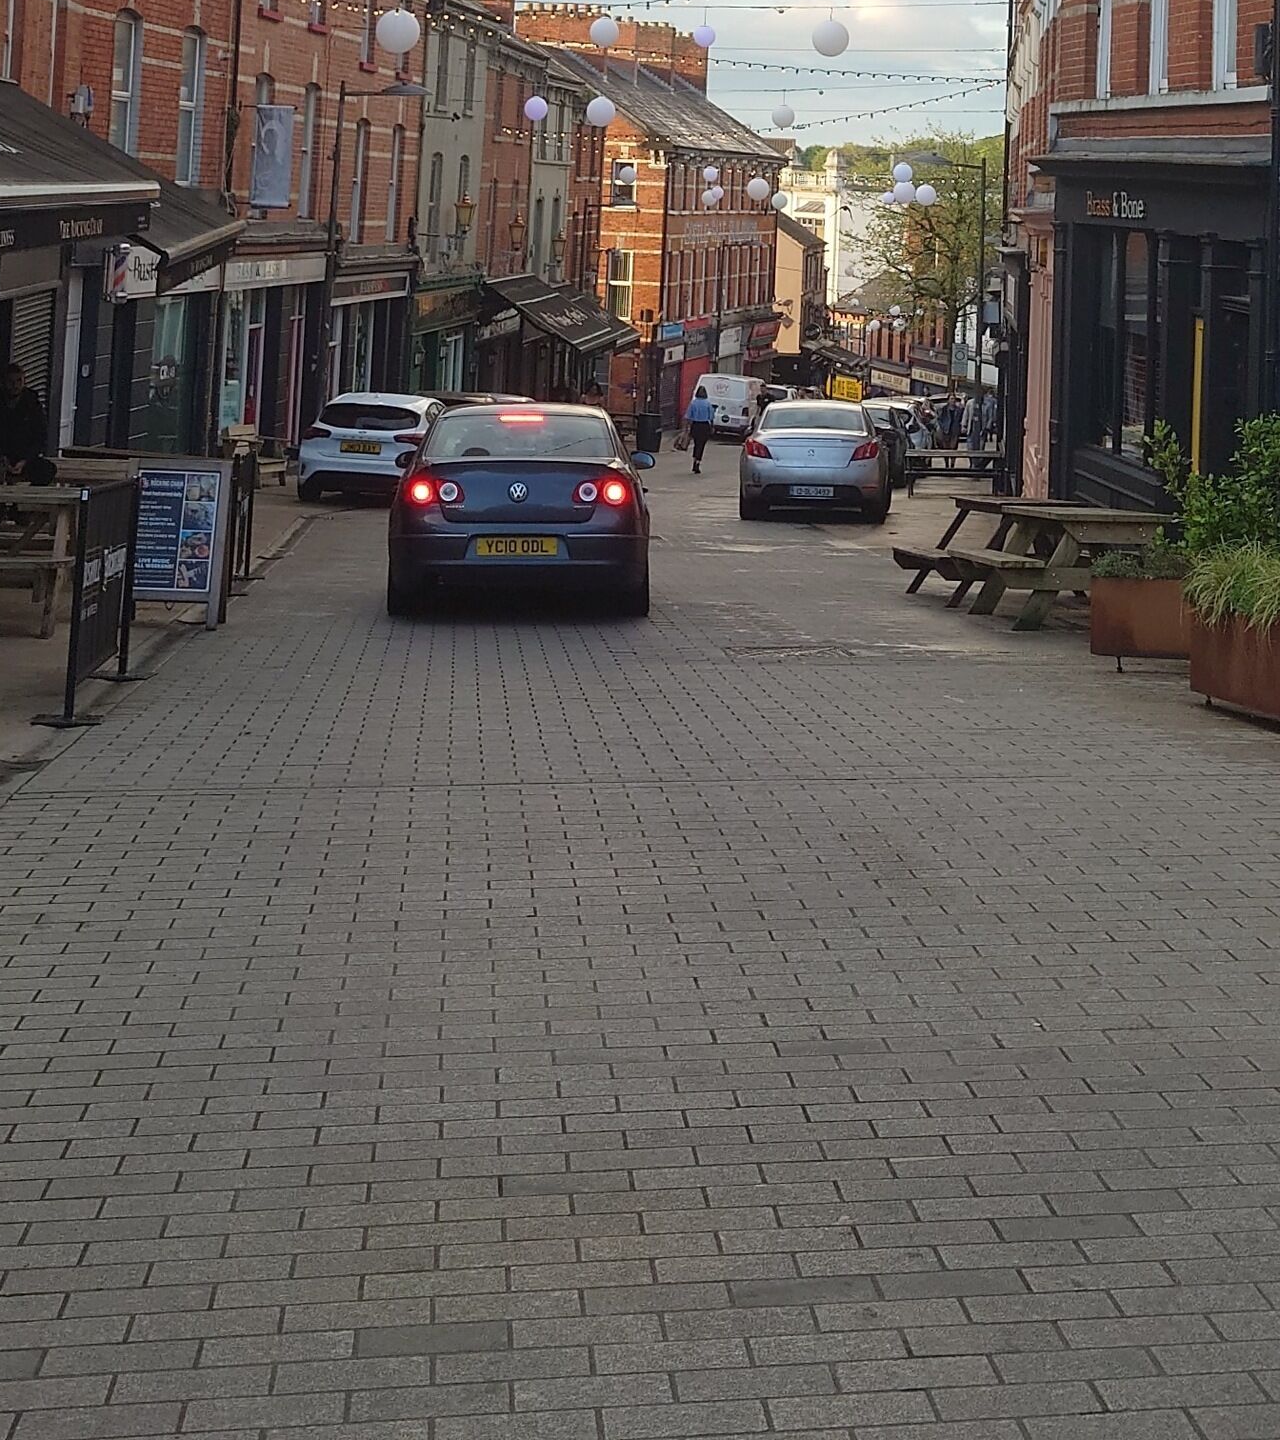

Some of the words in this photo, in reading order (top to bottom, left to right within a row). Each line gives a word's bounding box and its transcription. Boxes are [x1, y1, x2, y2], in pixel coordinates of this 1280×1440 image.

[1086, 190, 1111, 216] Brass
[1112, 191, 1119, 217] &
[1120, 191, 1145, 218] Bone
